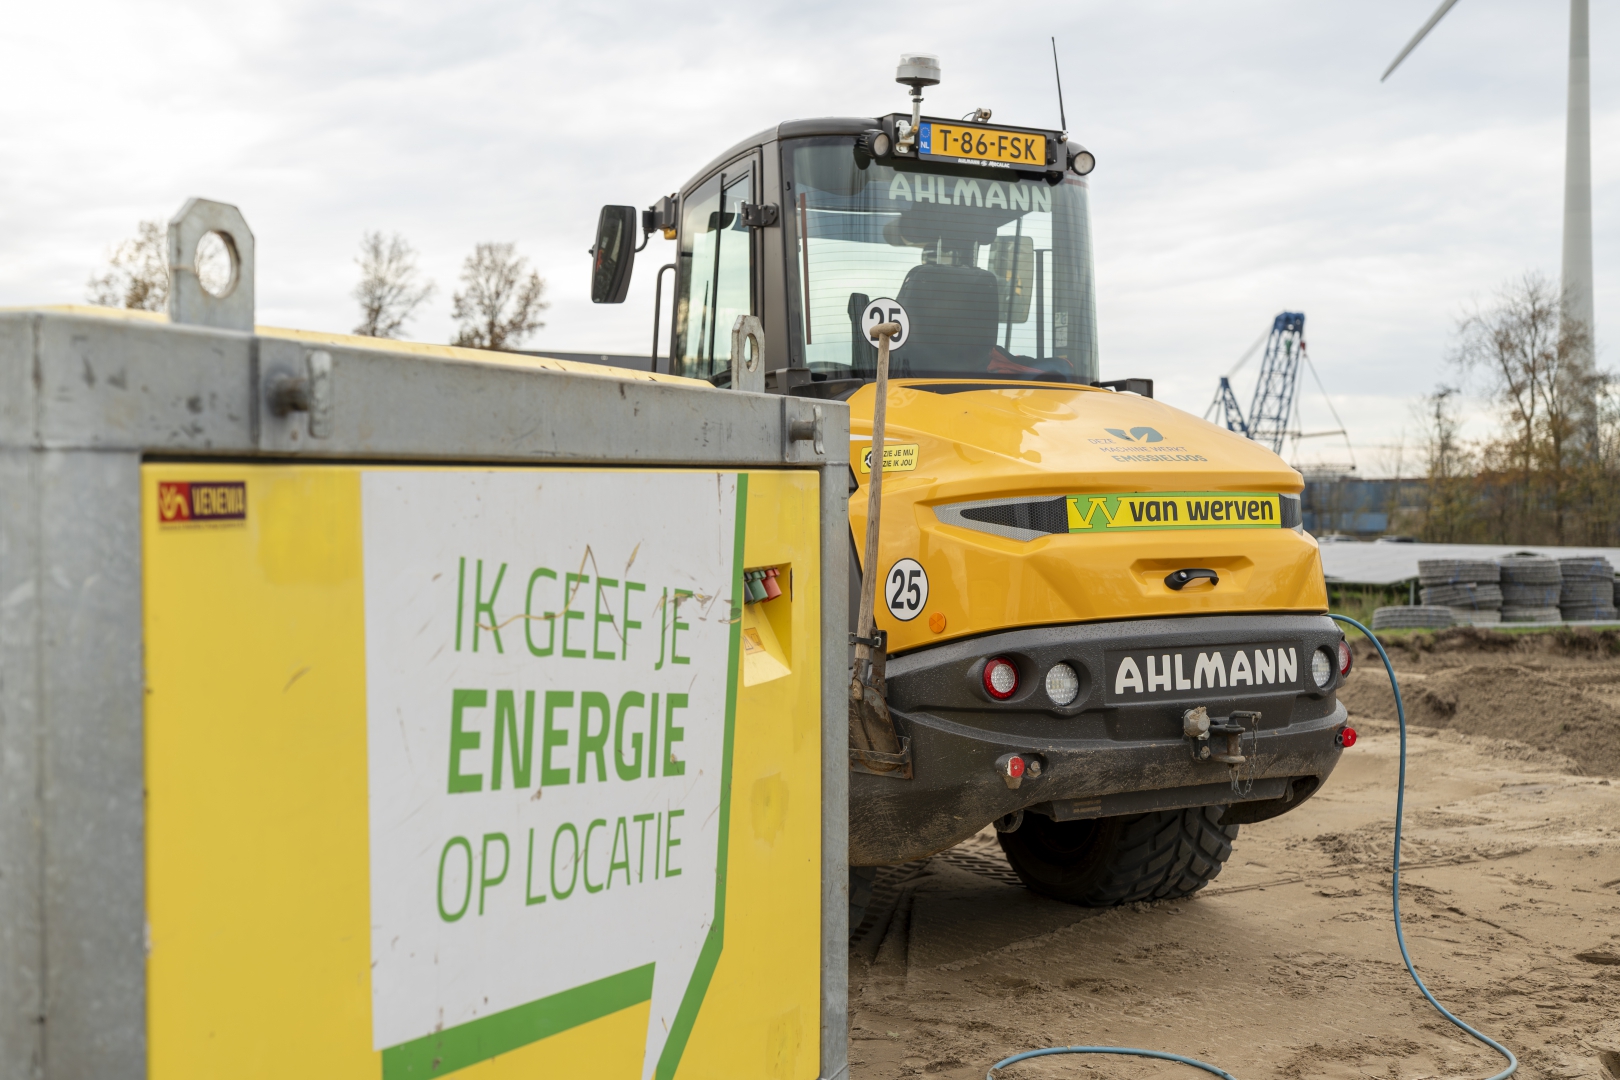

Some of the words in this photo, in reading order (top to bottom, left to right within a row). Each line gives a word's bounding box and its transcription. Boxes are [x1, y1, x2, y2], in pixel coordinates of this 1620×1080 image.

[920, 141, 930, 150] NL
[939, 129, 1037, 161] T-86-FSK
[888, 173, 1052, 213] AHLMANN
[894, 449, 902, 457] JE
[903, 448, 914, 456] MIJ
[901, 459, 913, 467] JOU
[1111, 454, 1208, 462] EMISSIELOOS
[191, 486, 244, 516] VENEMA
[1129, 500, 1179, 522] van
[1186, 499, 1274, 521] werven
[890, 568, 922, 611] 25
[454, 556, 508, 654] IK
[523, 567, 647, 662] GEEF
[654, 586, 694, 671] JE
[1114, 647, 1298, 695] AHLMANN
[447, 688, 690, 795] ENERGIE
[436, 832, 511, 924] OP
[525, 809, 686, 907] LOCATIE
